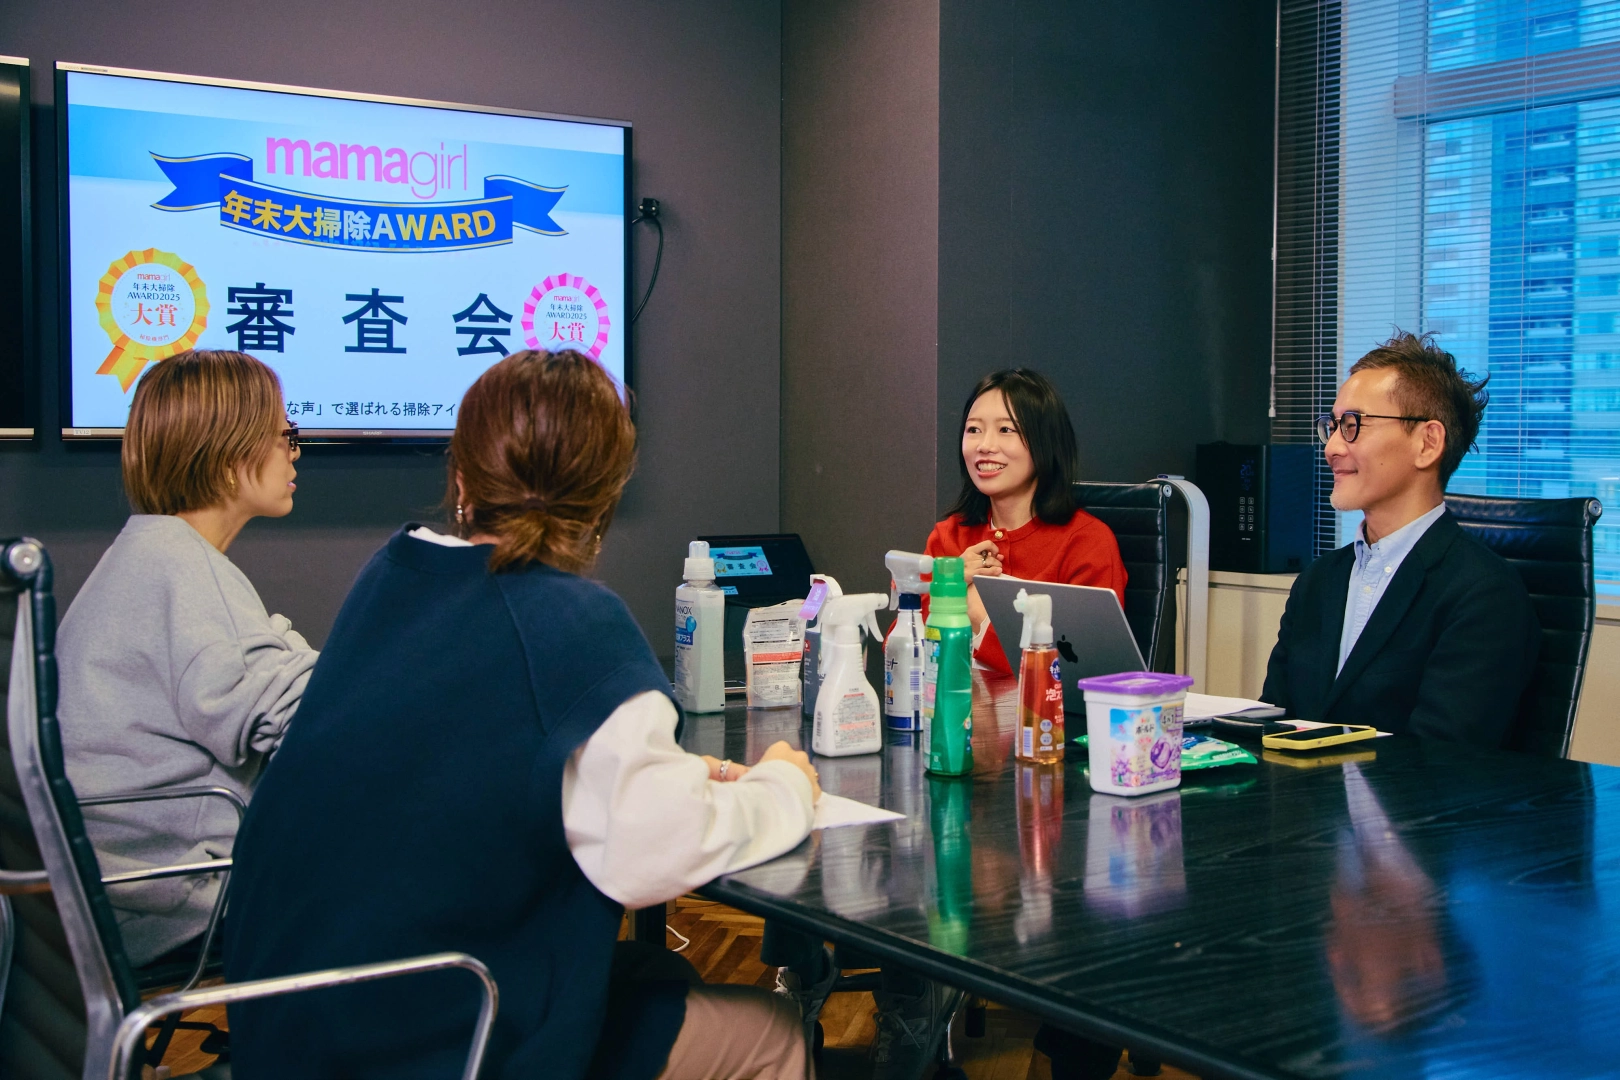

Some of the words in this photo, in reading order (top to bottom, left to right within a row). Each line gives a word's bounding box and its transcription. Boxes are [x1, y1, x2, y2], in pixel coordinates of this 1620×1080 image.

[266, 137, 467, 199] mamagirl
[221, 189, 497, 241] 年末大掃除AWARD
[127, 291, 180, 301] AWARD2025
[130, 302, 178, 326] 大賞
[548, 321, 585, 342] 大賞
